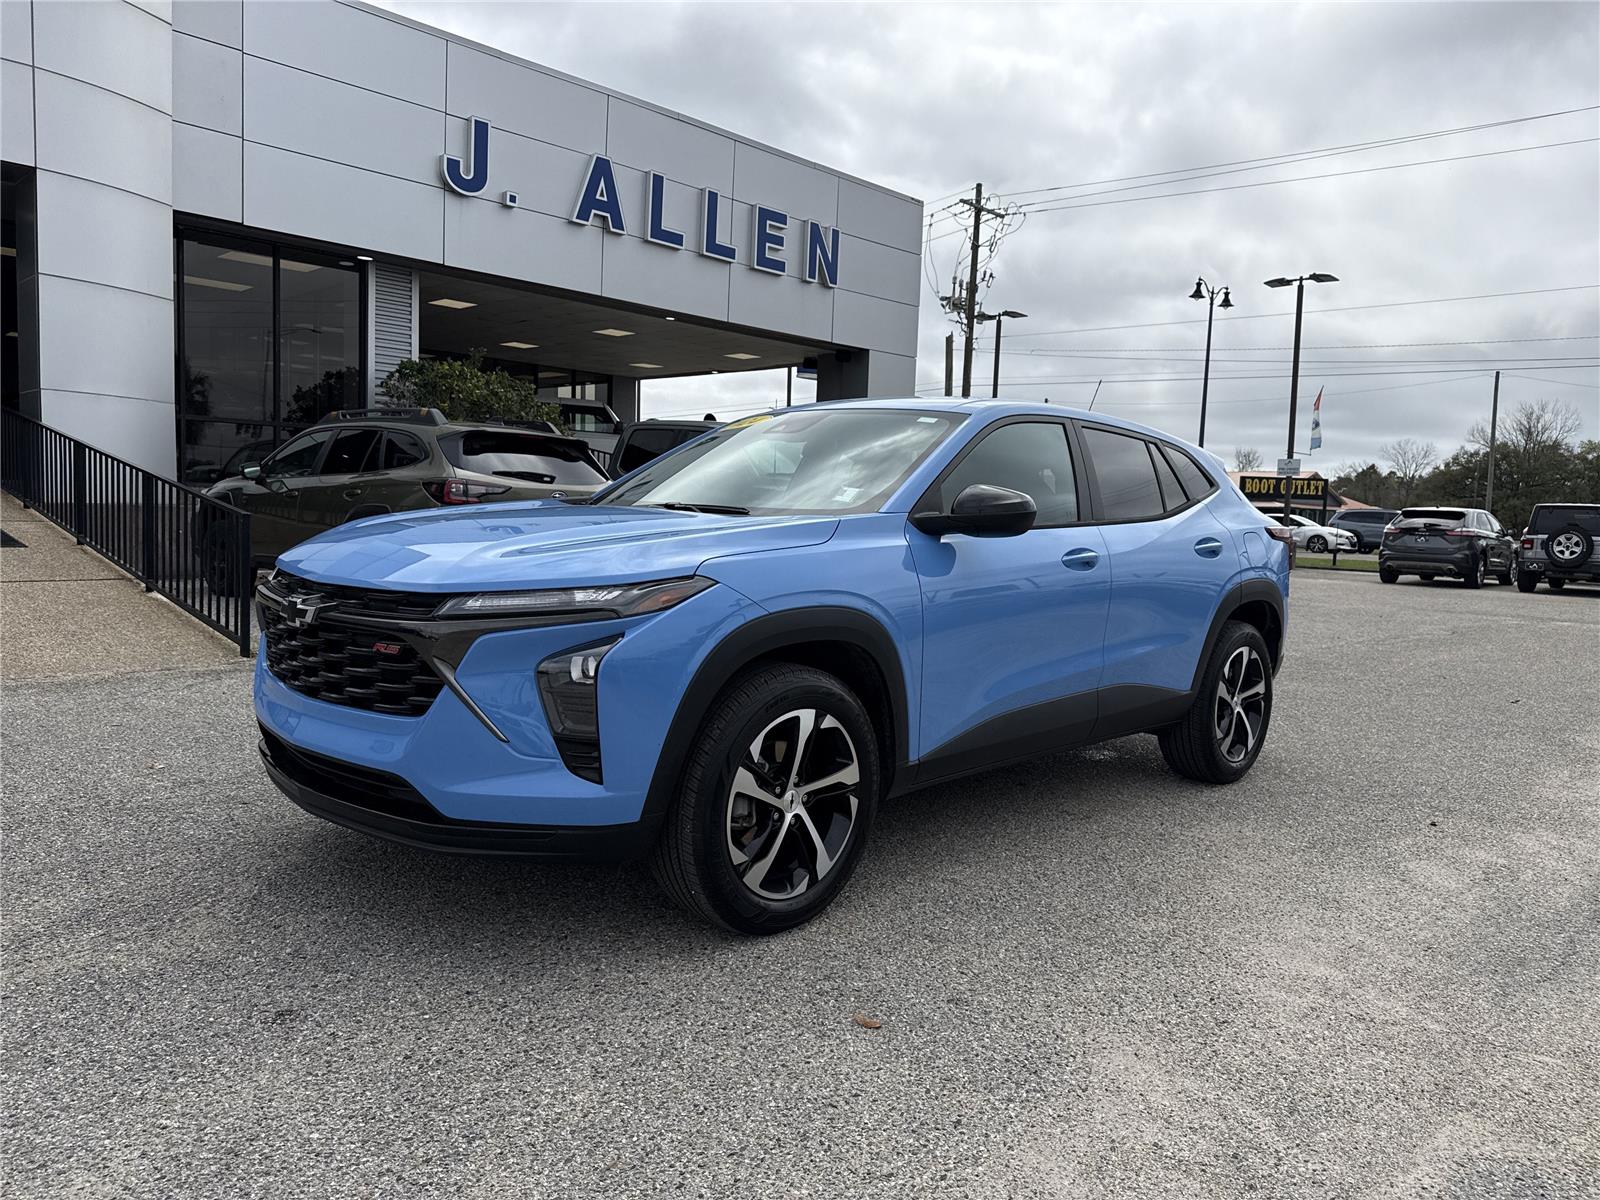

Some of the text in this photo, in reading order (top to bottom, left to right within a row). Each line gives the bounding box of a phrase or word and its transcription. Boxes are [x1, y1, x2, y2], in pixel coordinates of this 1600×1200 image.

[440, 116, 841, 287] J. ALLEN
[1245, 479, 1276, 494] BOOT
[373, 642, 401, 655] RS
